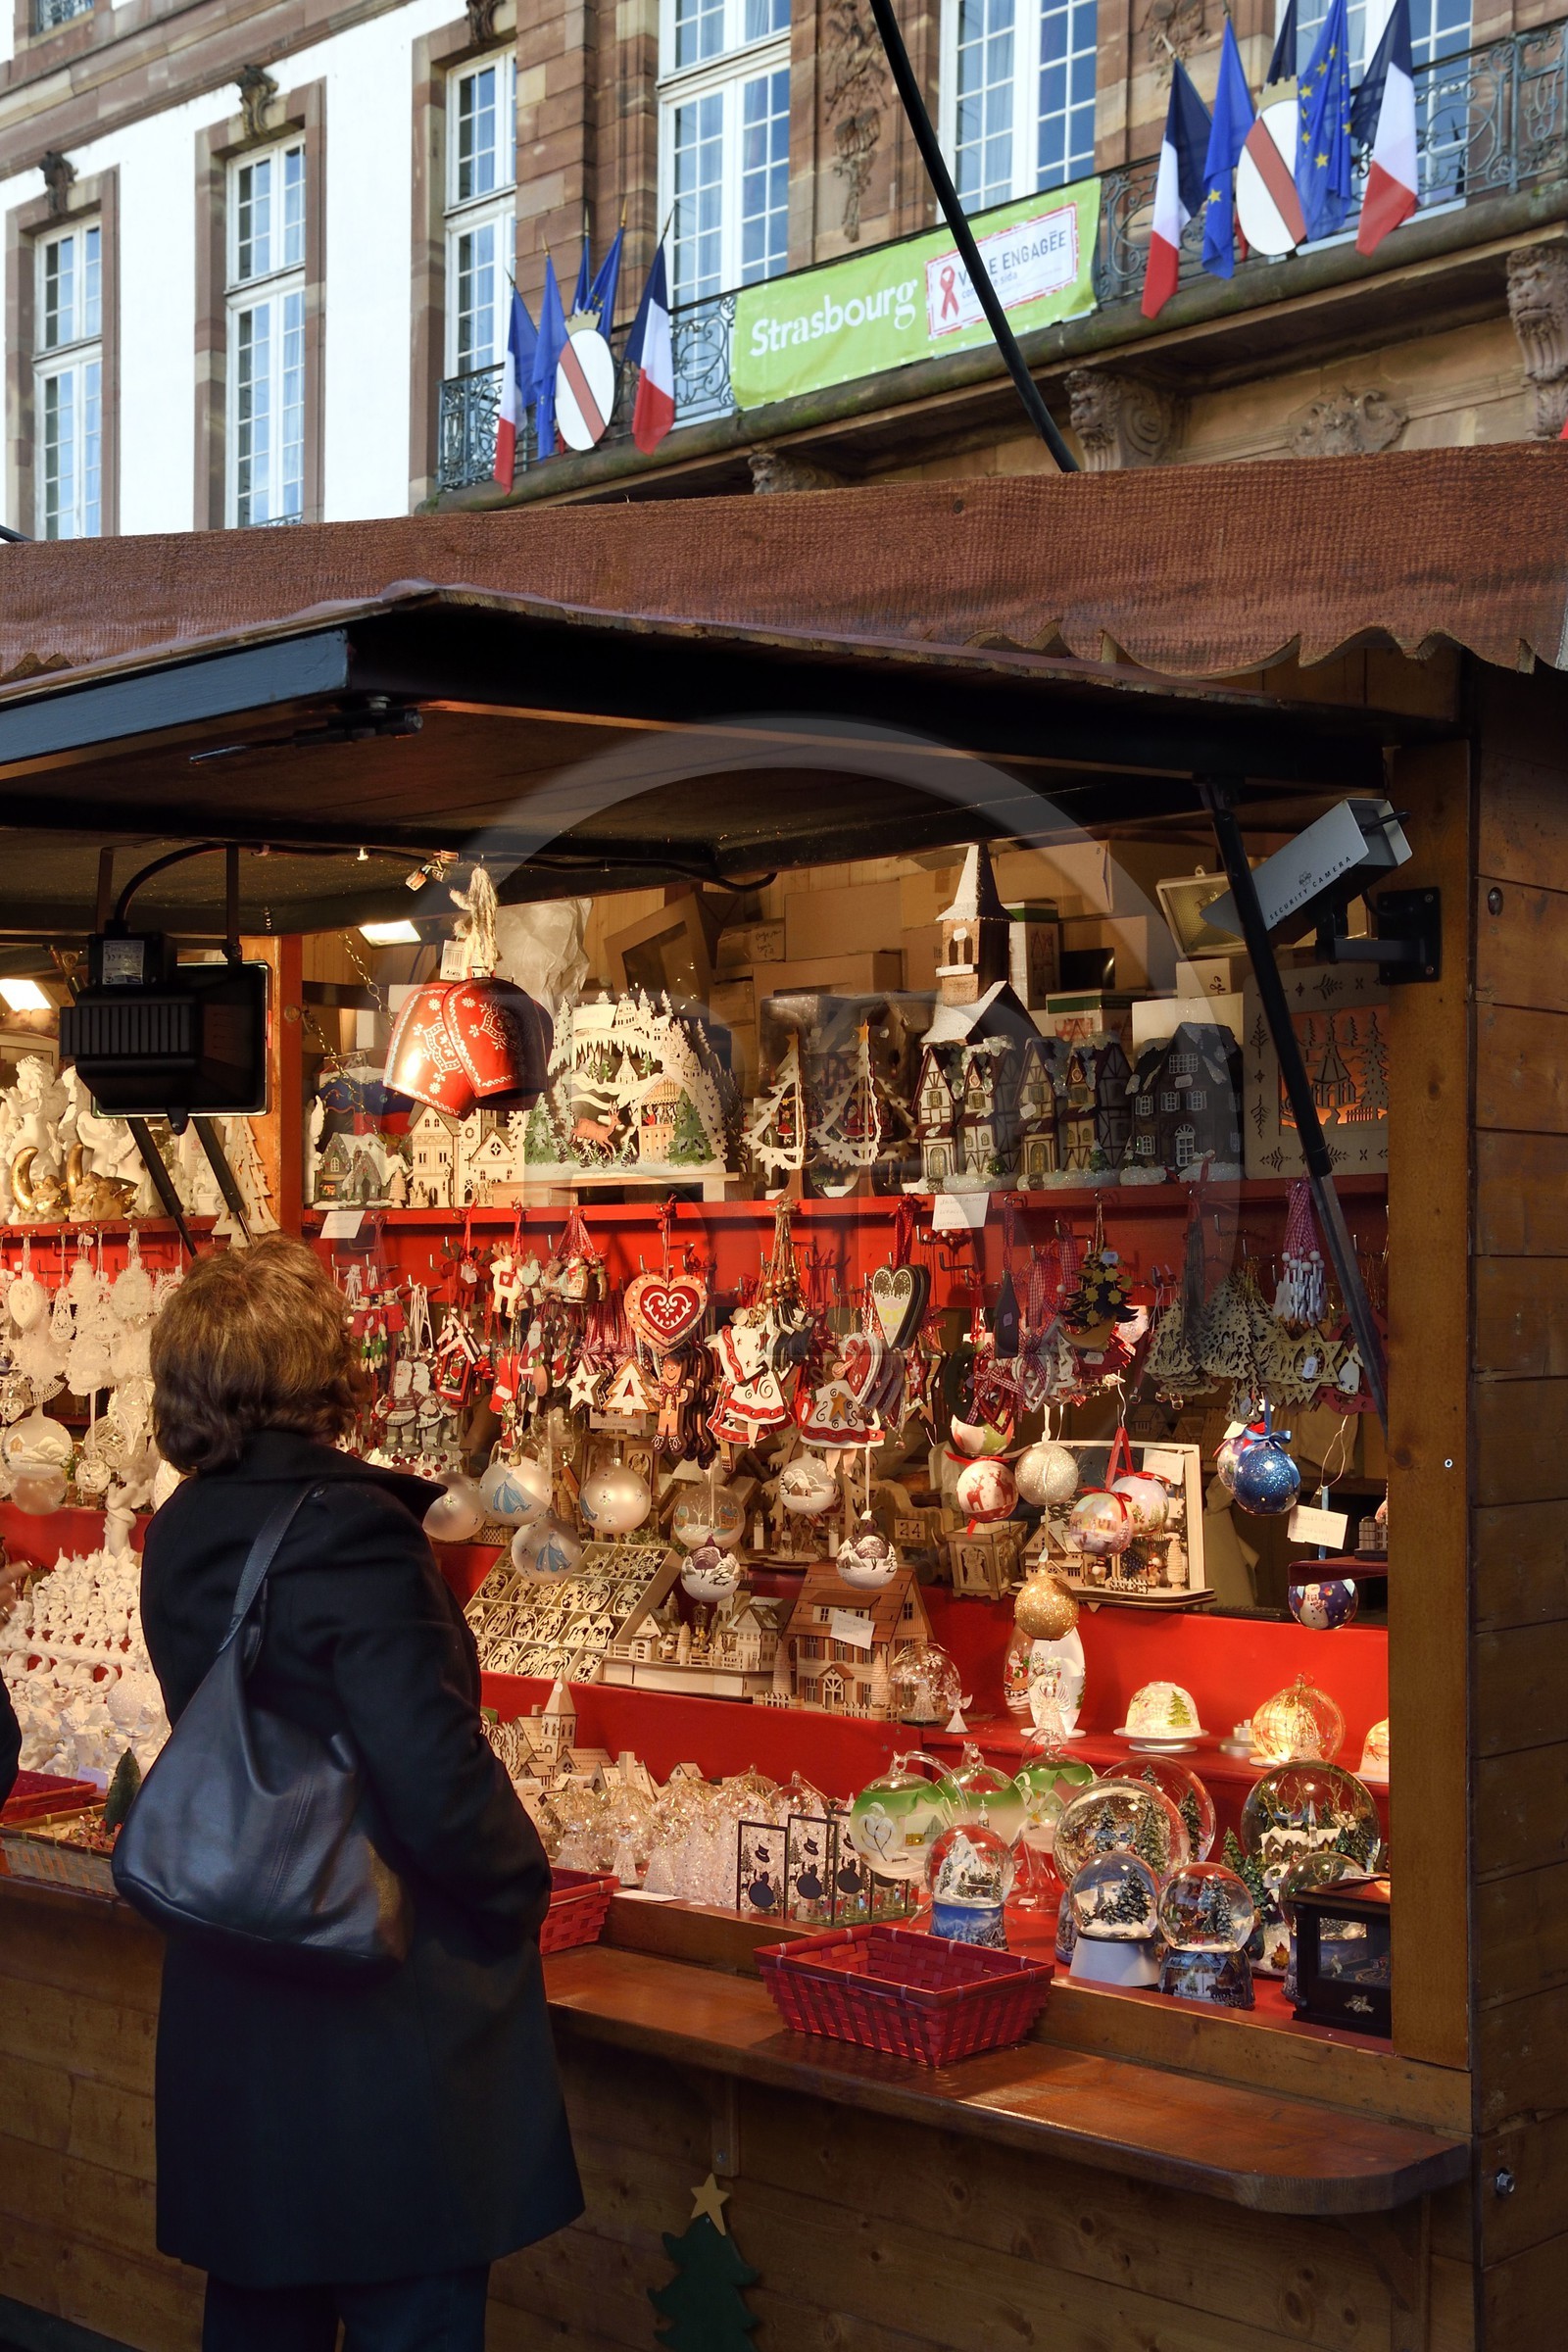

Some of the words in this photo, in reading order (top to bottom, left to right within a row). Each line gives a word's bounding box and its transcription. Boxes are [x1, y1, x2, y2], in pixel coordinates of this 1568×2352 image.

[1003, 229, 1067, 270] ENGAGÉE
[750, 278, 918, 357] Strasbourg
[1269, 888, 1308, 920] SECURITY
[1312, 856, 1351, 888] CAMERA
[900, 1522, 921, 1538] 24
